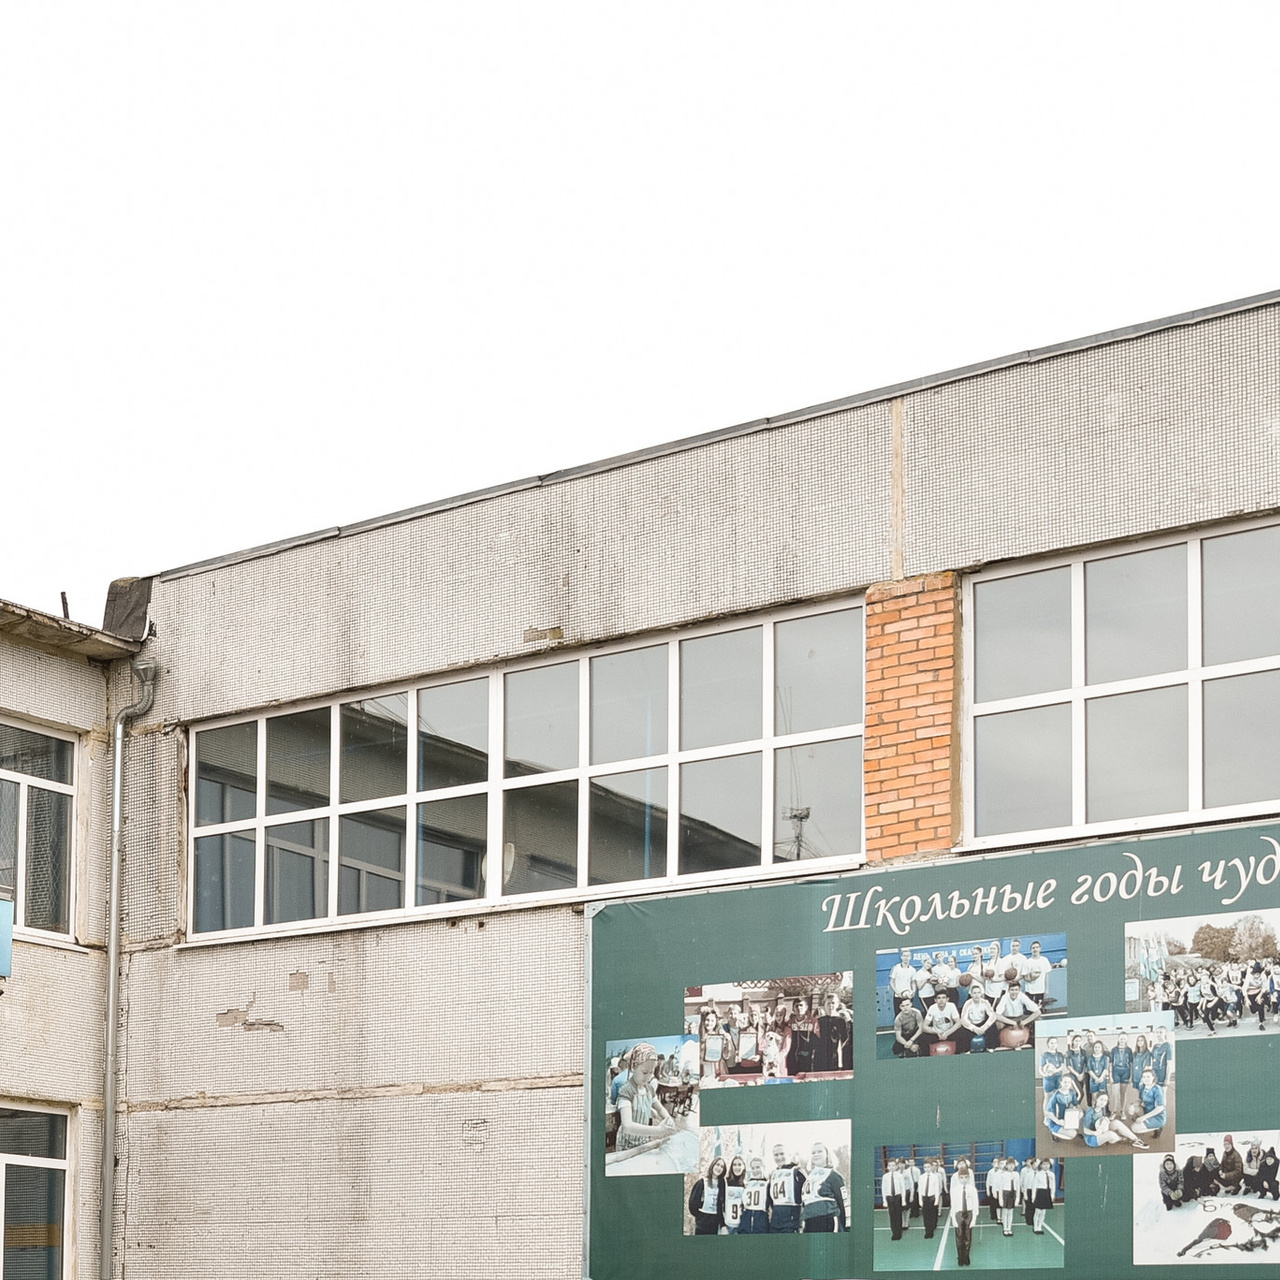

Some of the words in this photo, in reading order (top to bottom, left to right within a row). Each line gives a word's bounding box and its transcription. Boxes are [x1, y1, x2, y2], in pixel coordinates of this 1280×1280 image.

[821, 878, 1057, 936] Школьные
[1070, 852, 1185, 904] годы
[746, 1190, 760, 1207] 30
[772, 1181, 786, 1199] 04
